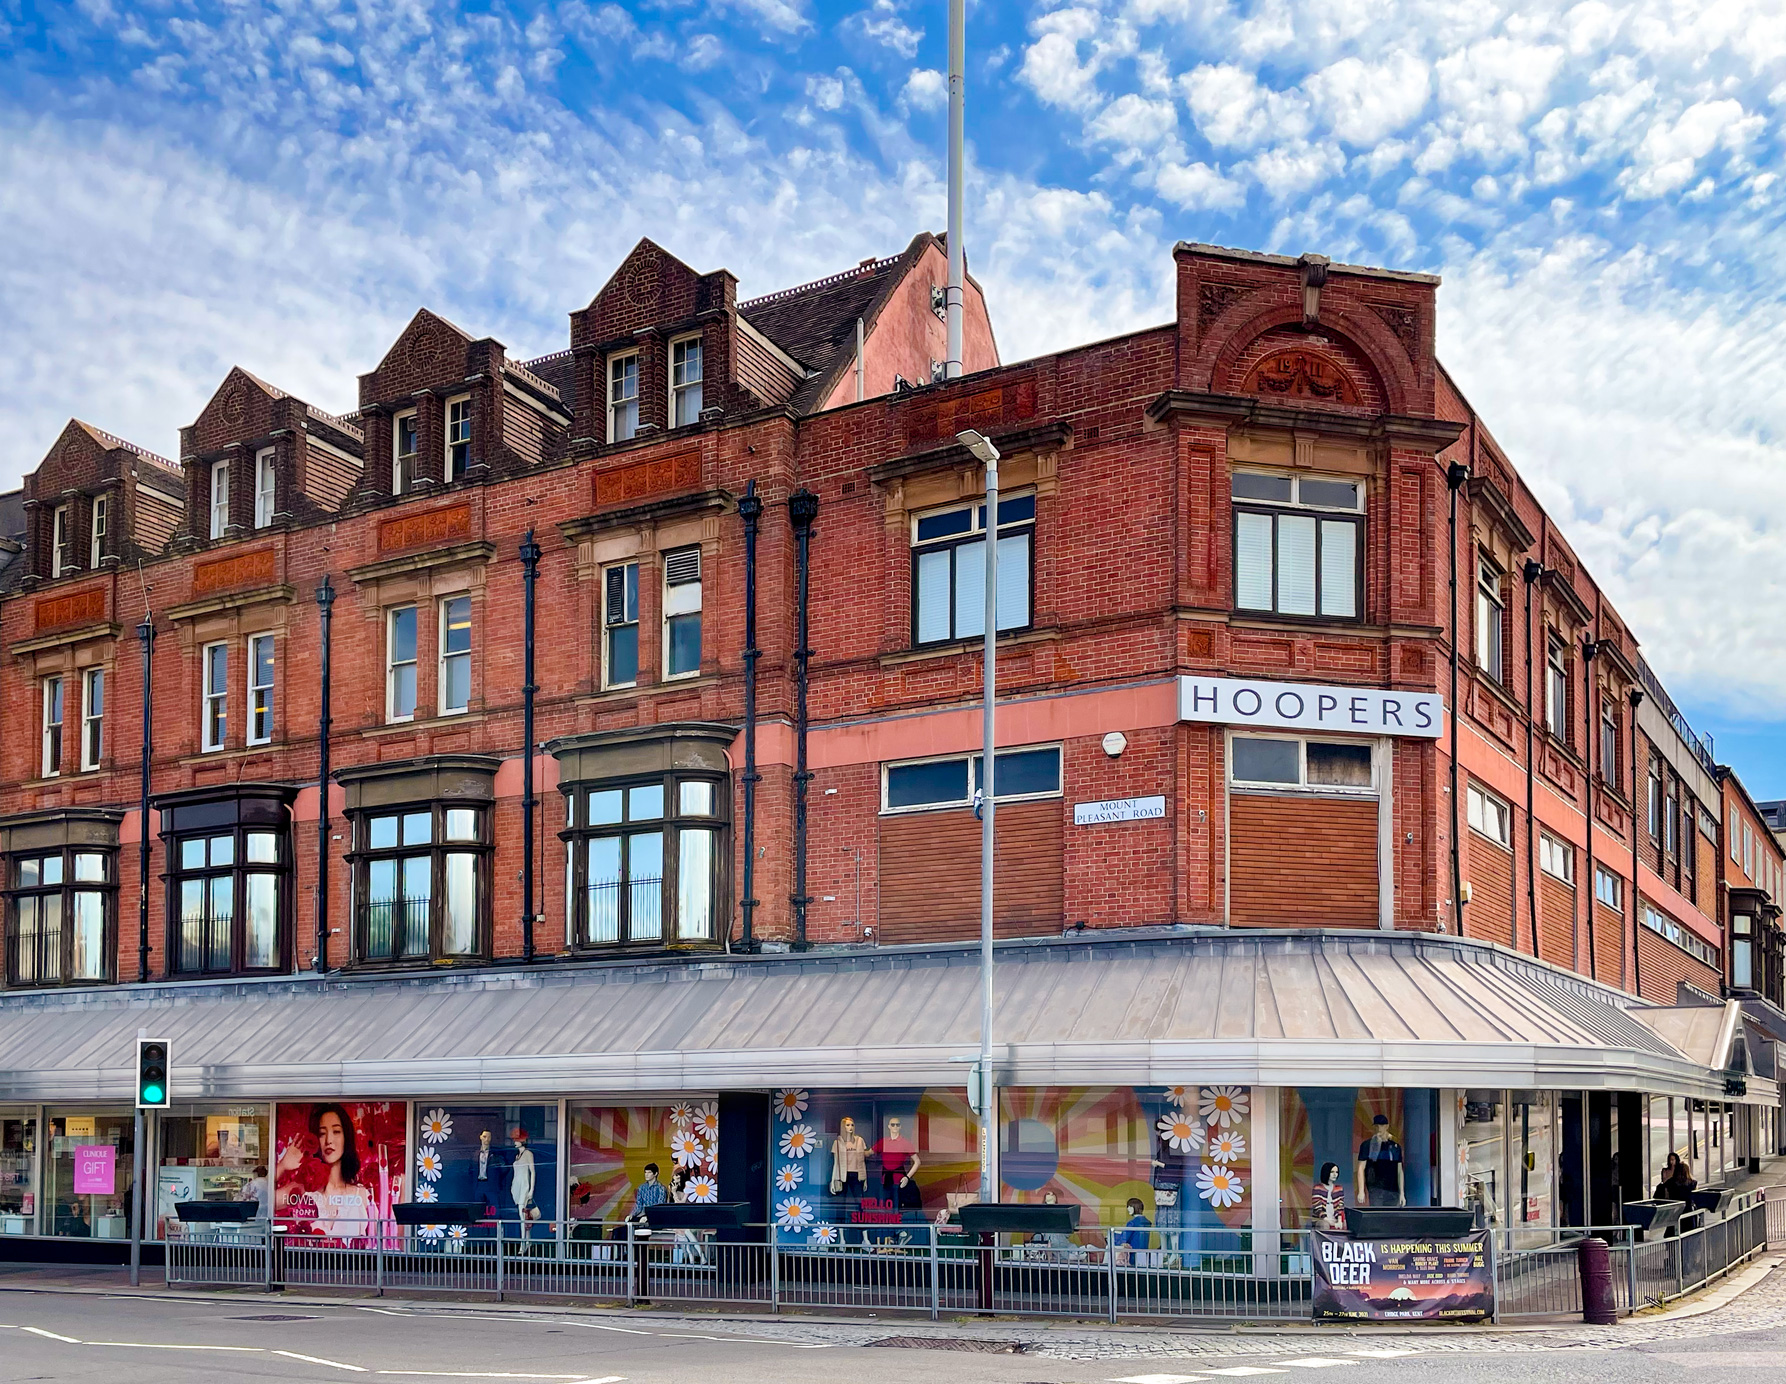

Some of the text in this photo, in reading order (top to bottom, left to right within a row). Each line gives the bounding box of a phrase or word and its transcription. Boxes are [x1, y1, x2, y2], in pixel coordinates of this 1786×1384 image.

[1279, 358, 1292, 373] 19
[1193, 685, 1432, 728] HOOPERS
[1099, 800, 1138, 811] MOUNT
[1077, 808, 1162, 823] PLEASANT ROAD
[82, 1150, 108, 1158] CLINIQUE
[83, 1161, 107, 1175] GIFT
[861, 1197, 893, 1209] HELLO
[851, 1212, 902, 1224] SUNSHINE
[1322, 1241, 1377, 1263] BLACK
[1380, 1242, 1484, 1254] IS HAPPENING THIS SUMMER
[1329, 1263, 1371, 1285] DEER
